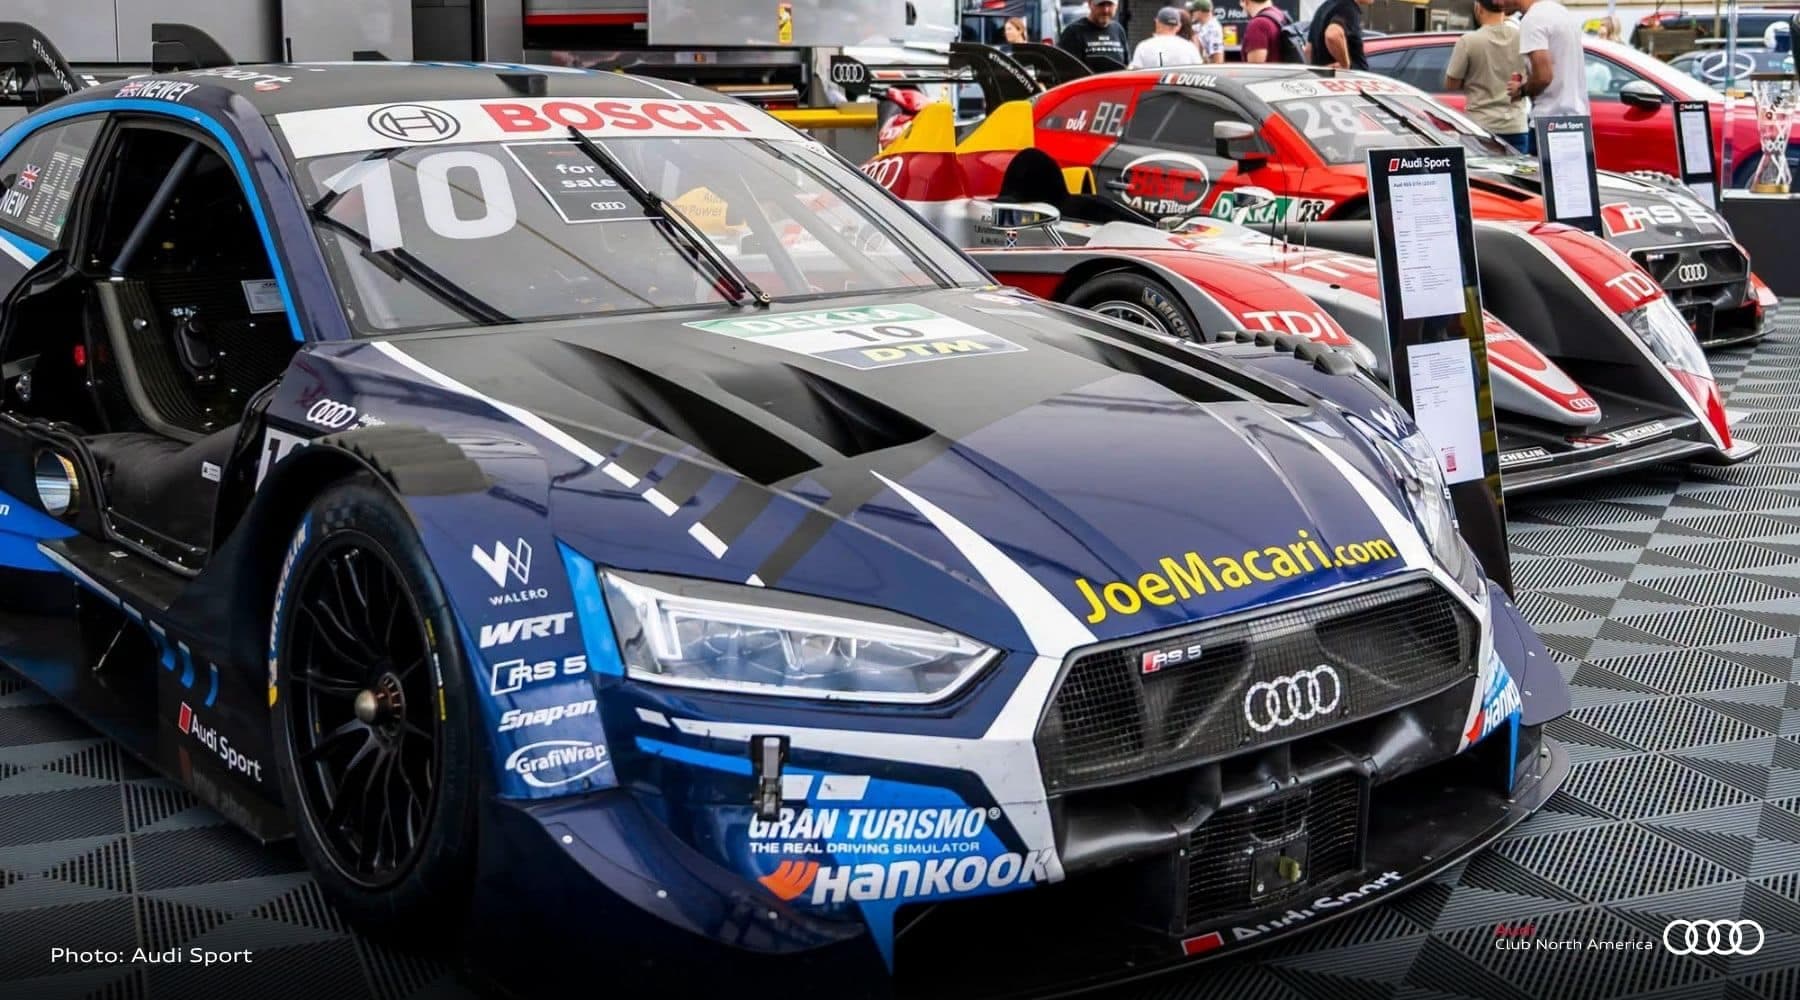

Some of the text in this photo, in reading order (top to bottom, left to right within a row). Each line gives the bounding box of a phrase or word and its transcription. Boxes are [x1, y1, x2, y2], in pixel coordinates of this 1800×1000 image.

[137, 80, 200, 103] NEWEY
[1176, 73, 1217, 88] DUVAL
[480, 103, 752, 134] BOSCH
[1066, 118, 1087, 131] DUV
[1285, 99, 1362, 138] 28
[1555, 121, 1567, 129] Audi
[556, 163, 595, 174] for
[1400, 156, 1451, 171] Audi Sport
[561, 177, 617, 188] sale
[322, 151, 517, 252] 10
[1129, 196, 1157, 213] Air
[1617, 205, 1682, 230] RS
[730, 305, 902, 333] DEKRA
[1241, 310, 1339, 341] TDI
[834, 326, 925, 342] 10
[859, 338, 992, 362] DTM
[1499, 449, 1545, 463] CHELIN
[1074, 530, 1398, 625] JoeMacari.com
[489, 588, 549, 606] WALERO
[480, 611, 574, 649] WRT
[1151, 644, 1202, 667] RS 5
[506, 654, 588, 687] RS 5
[498, 699, 598, 732] Snap-on
[191, 713, 263, 783] Audi Sport
[515, 743, 607, 775] GrafiWrap
[748, 808, 840, 840] GRAN
[750, 842, 980, 854] THE REAL DRIVING SIMULATOR
